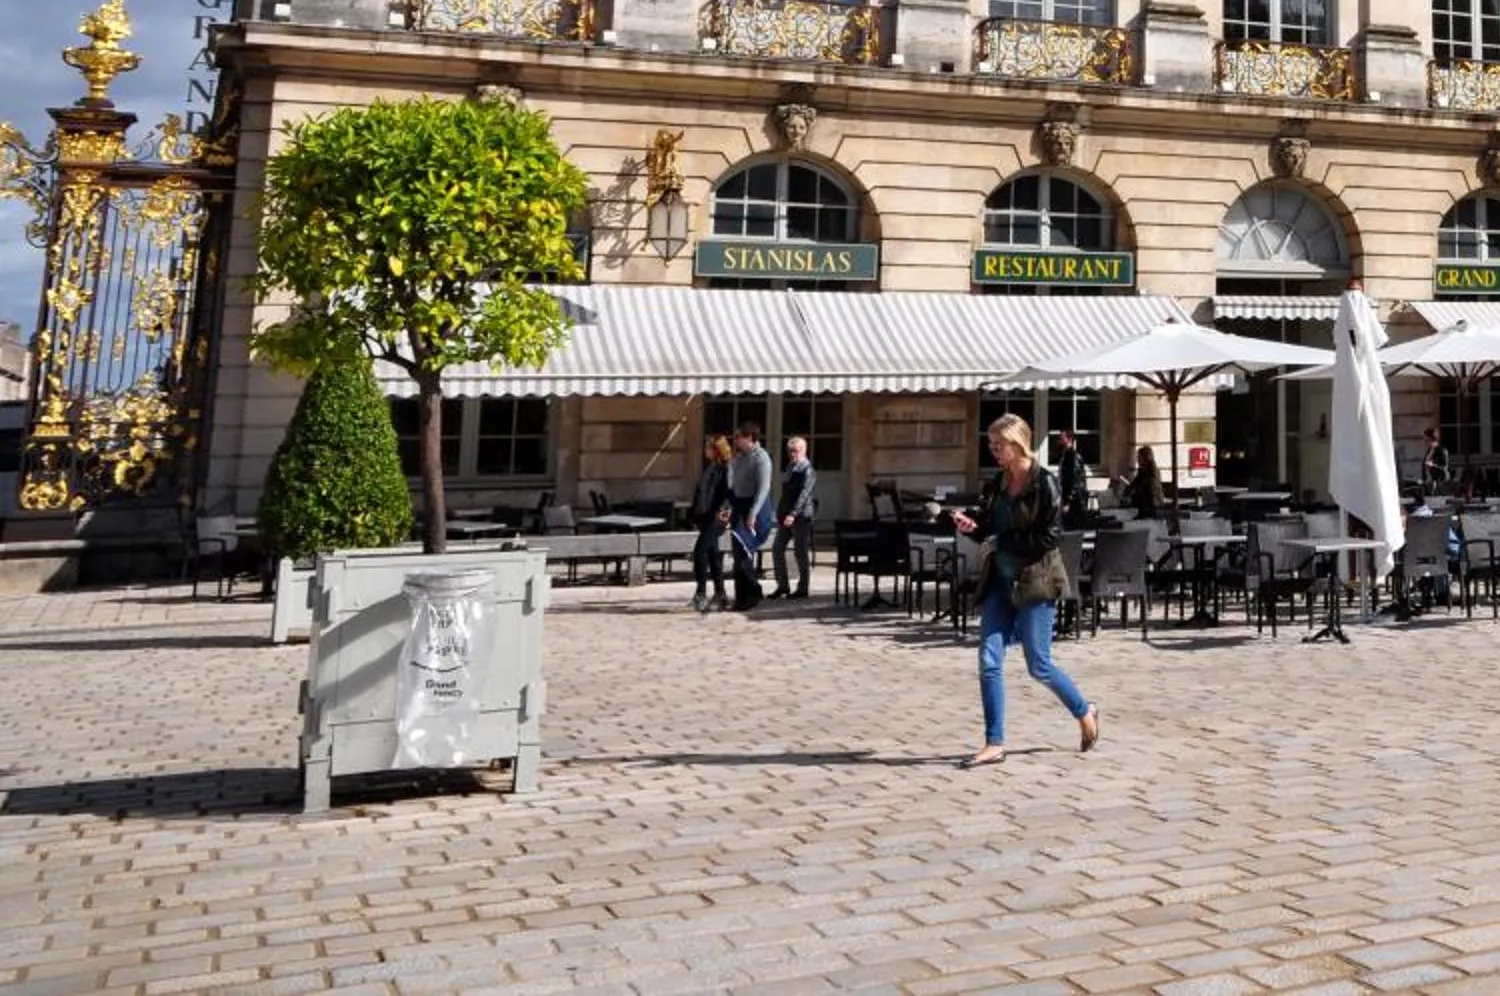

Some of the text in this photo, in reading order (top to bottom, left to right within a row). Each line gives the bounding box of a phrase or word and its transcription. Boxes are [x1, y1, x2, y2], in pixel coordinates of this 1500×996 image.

[723, 247, 852, 273] STANISLAS
[984, 255, 1123, 280] RESTAURANT
[1437, 268, 1497, 287] GRAND
